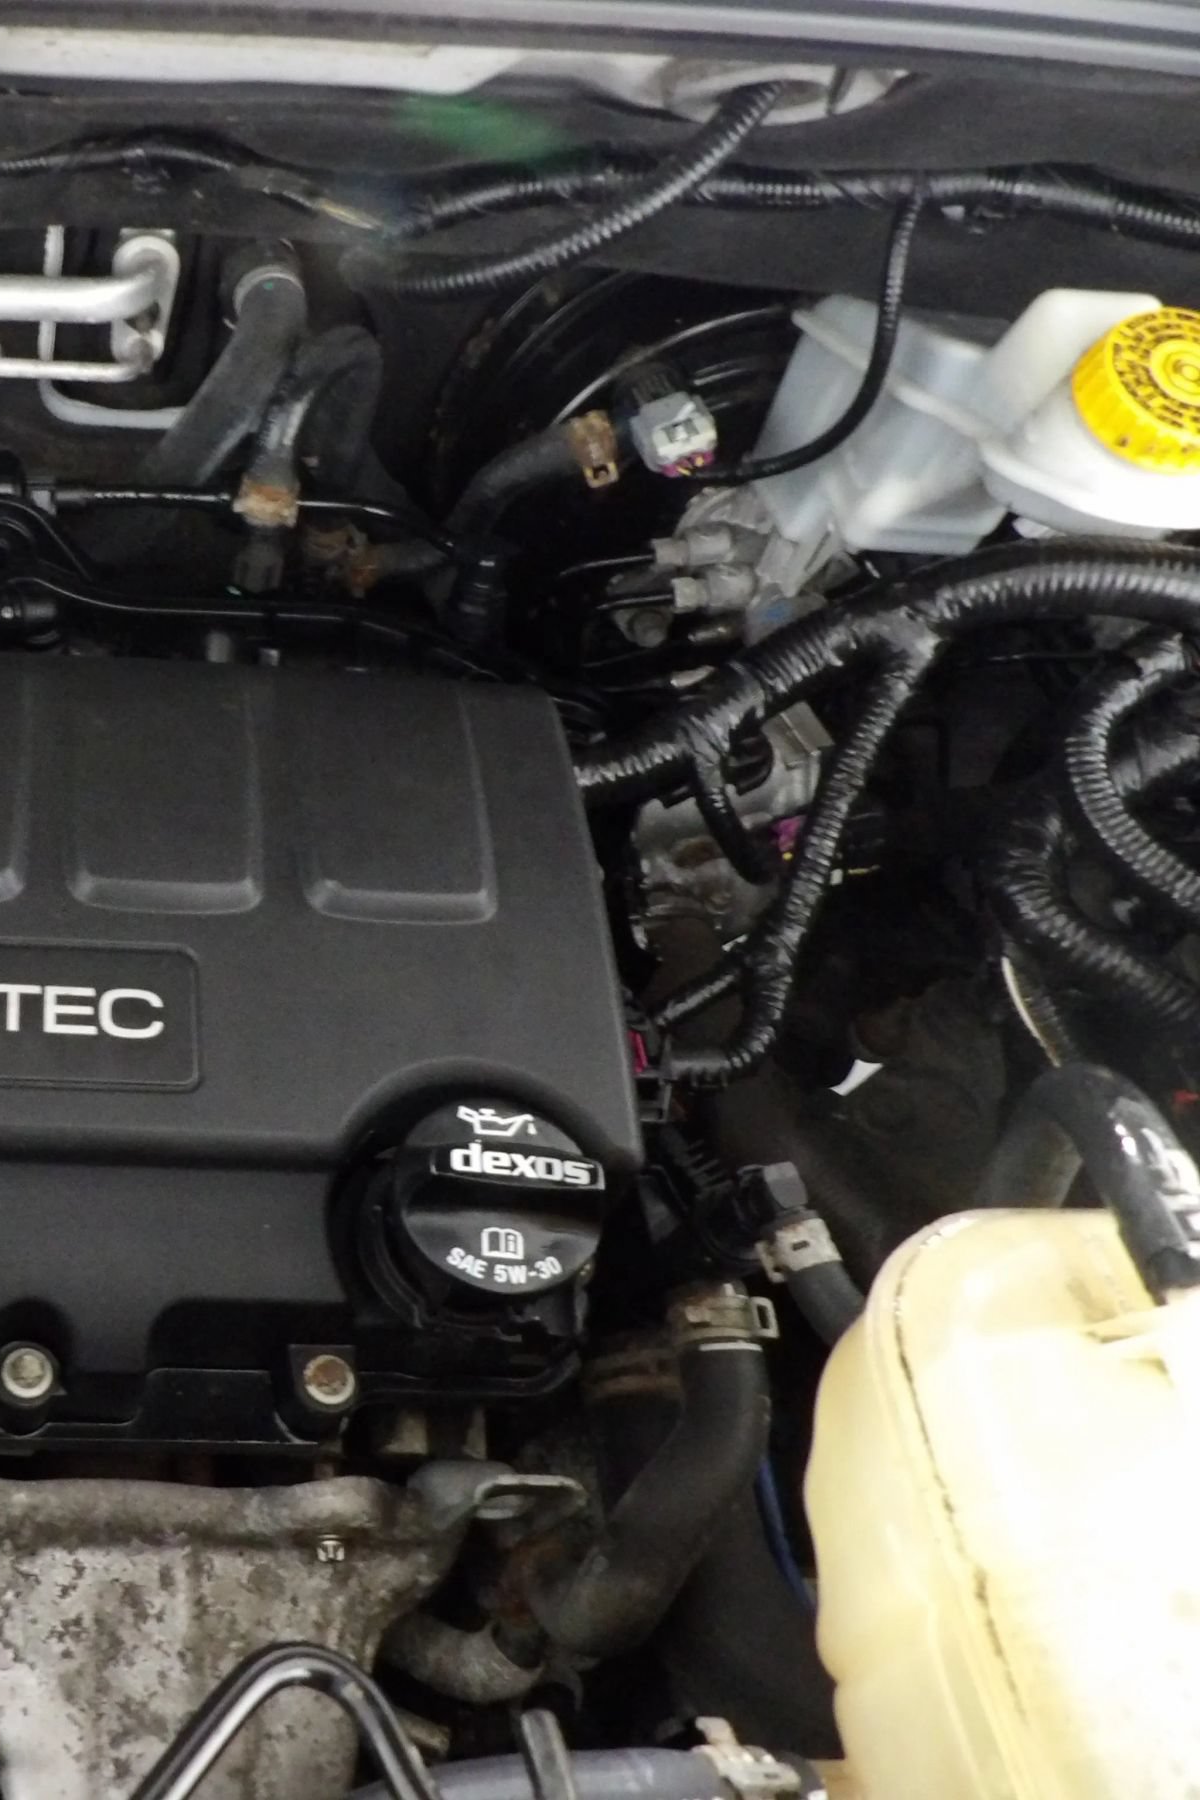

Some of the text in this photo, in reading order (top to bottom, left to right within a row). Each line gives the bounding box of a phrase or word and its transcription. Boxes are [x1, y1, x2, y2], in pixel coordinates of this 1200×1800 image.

[450, 1140, 594, 1185] dexos
[445, 1247, 563, 1285] SAE 5W-30
